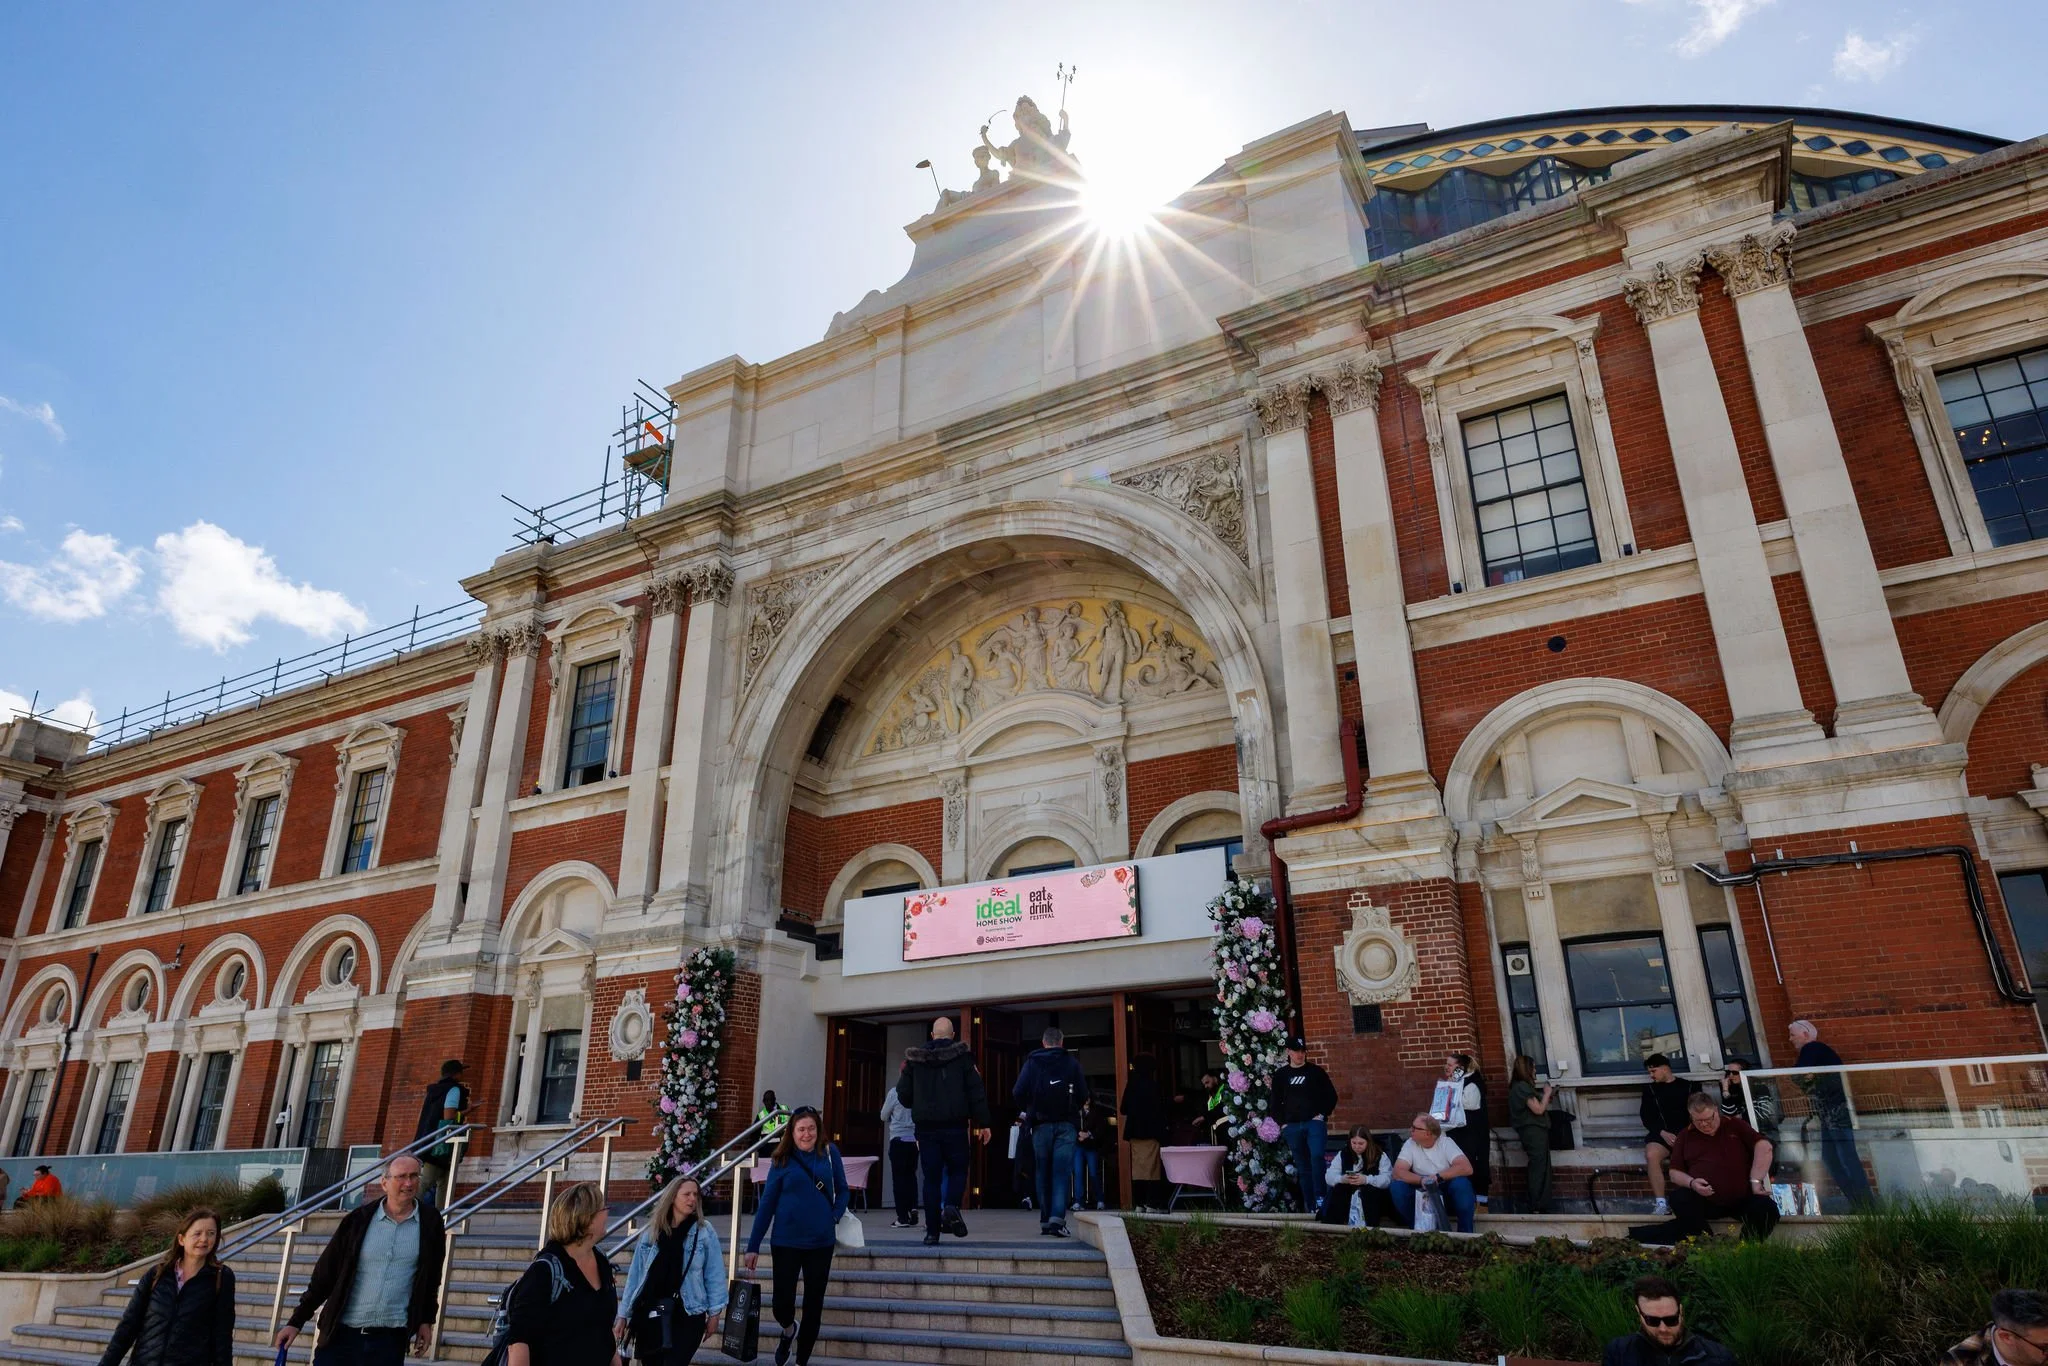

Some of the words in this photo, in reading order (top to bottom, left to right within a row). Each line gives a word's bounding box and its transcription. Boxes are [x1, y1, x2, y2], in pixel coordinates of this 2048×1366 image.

[976, 893, 1023, 920] ideal
[1029, 900, 1054, 915] drink
[976, 918, 998, 927] HOME
[999, 916, 1023, 925] SHOW
[1029, 913, 1055, 921] FESTIVAL
